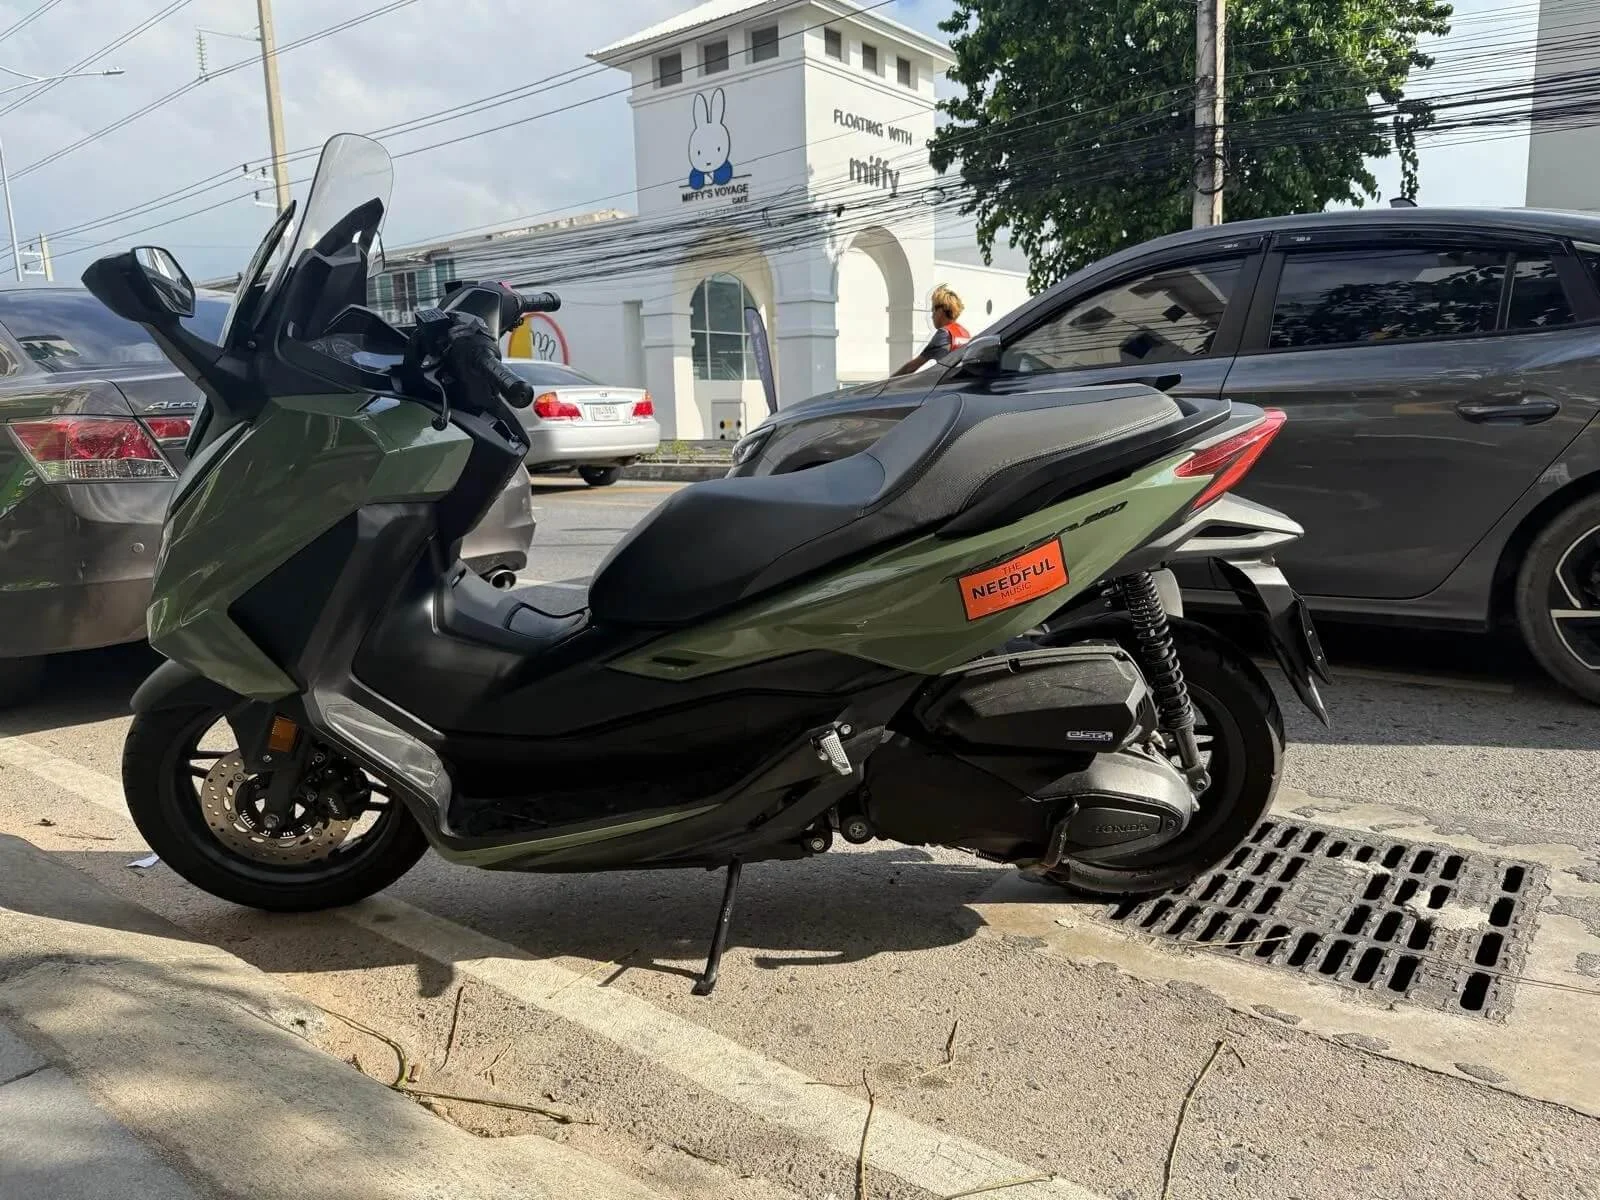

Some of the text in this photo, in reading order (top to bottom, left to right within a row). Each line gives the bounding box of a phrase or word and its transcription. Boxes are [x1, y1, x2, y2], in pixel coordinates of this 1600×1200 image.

[833, 108, 913, 146] FLOATING WITH
[849, 155, 900, 197] miffy
[682, 183, 749, 202] MIFFY'S VOYAGE
[971, 558, 1056, 600] NEEDFUL
[1002, 561, 1022, 575] THE
[1001, 582, 1032, 600] MUSIC
